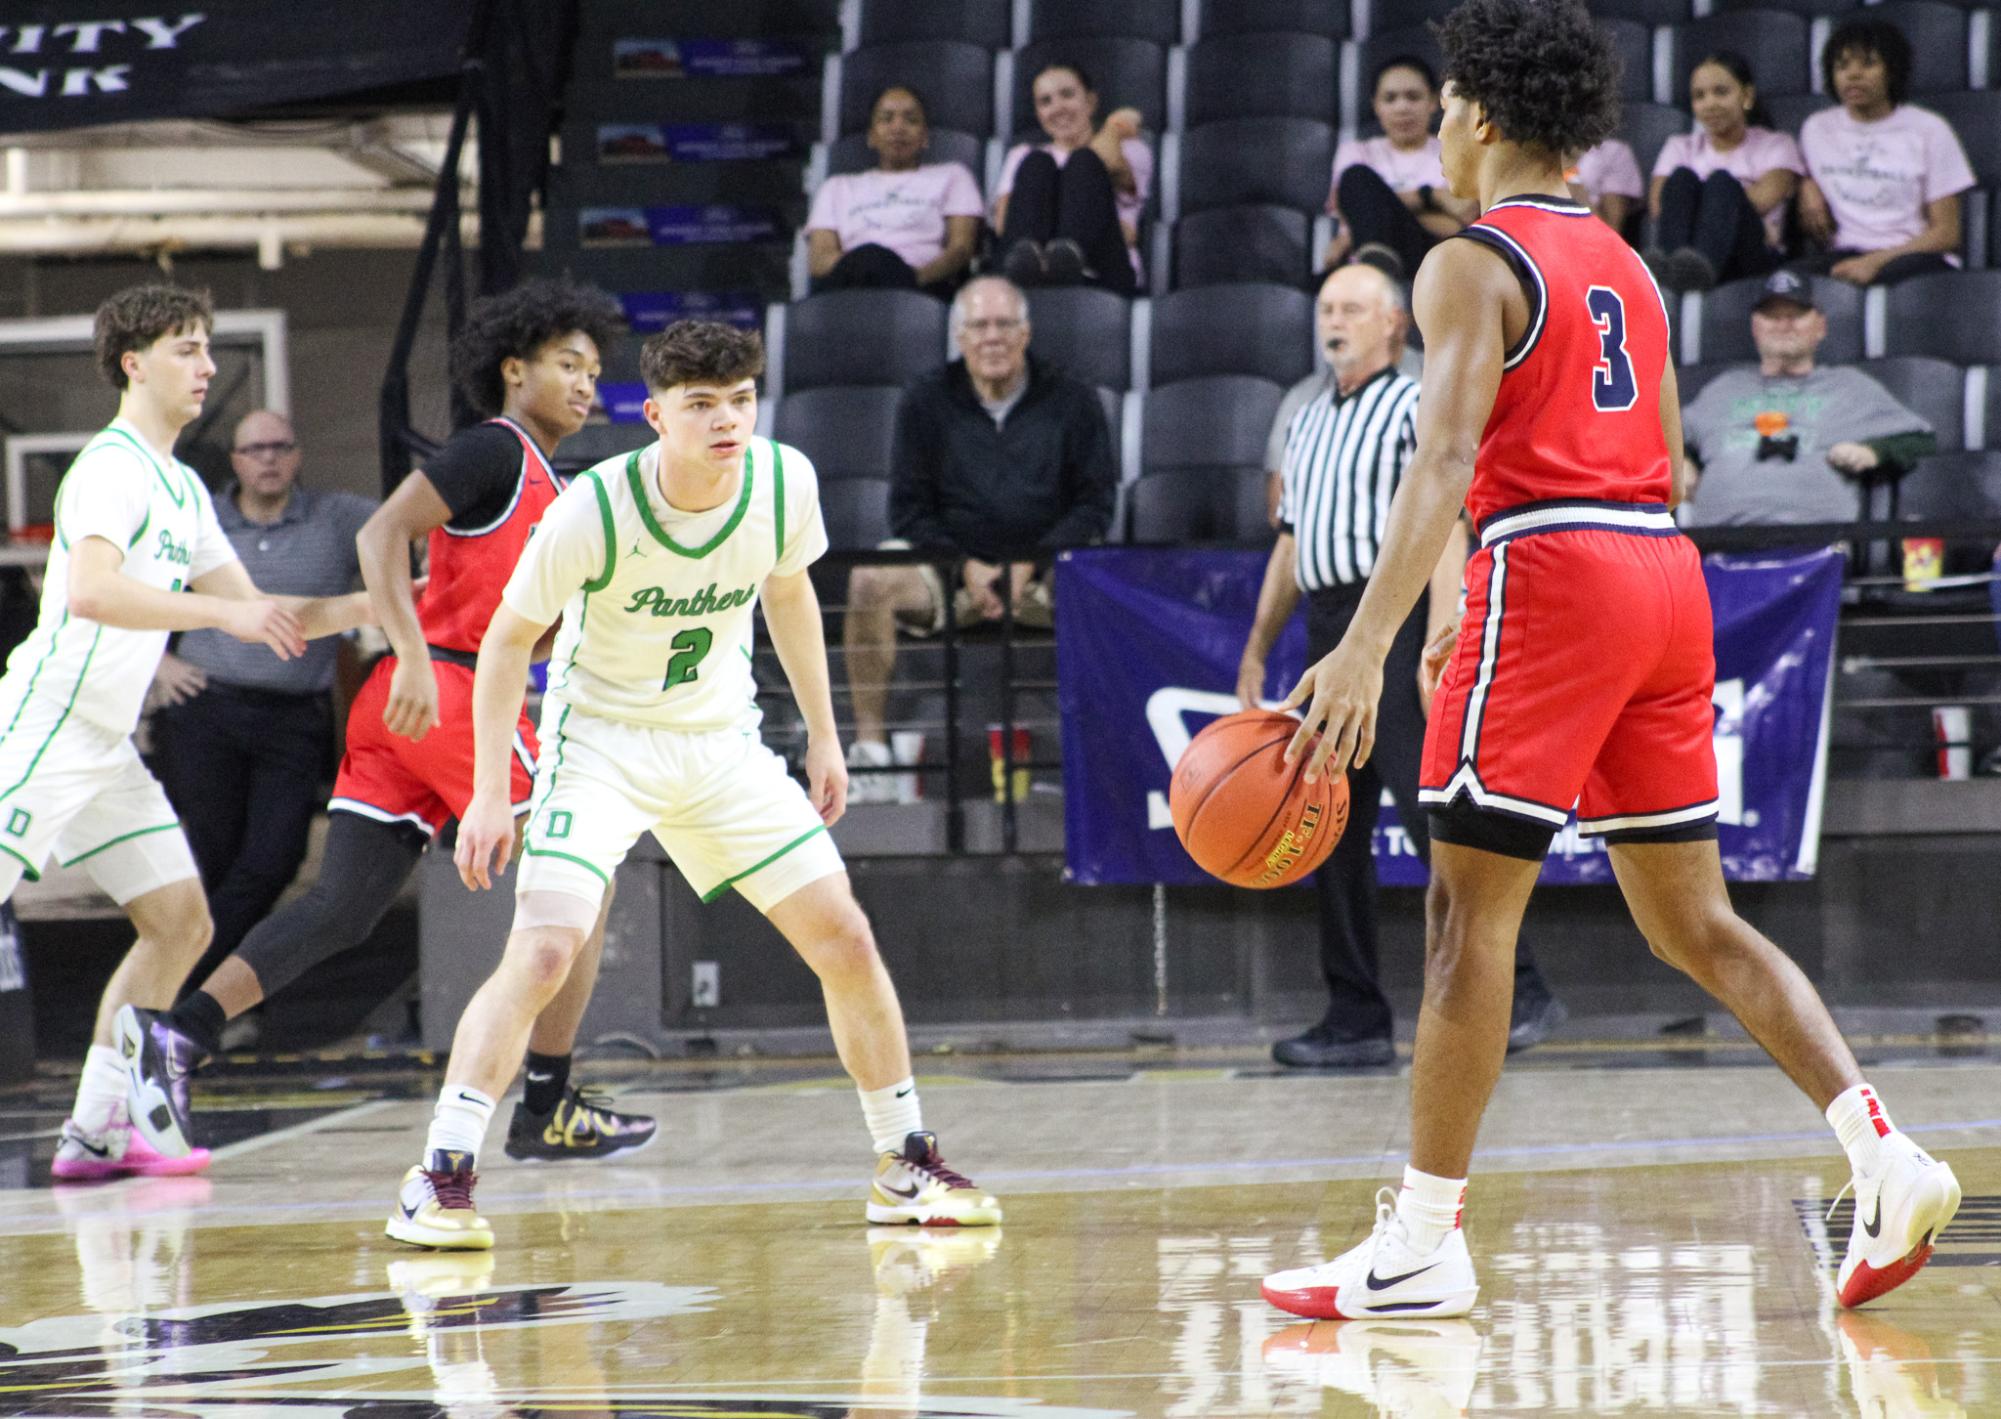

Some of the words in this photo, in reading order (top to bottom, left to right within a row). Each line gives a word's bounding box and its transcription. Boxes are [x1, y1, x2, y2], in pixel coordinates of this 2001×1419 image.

[1585, 284, 1639, 412] 3
[662, 626, 713, 691] 2
[6, 807, 32, 838] D
[546, 810, 574, 839] D
